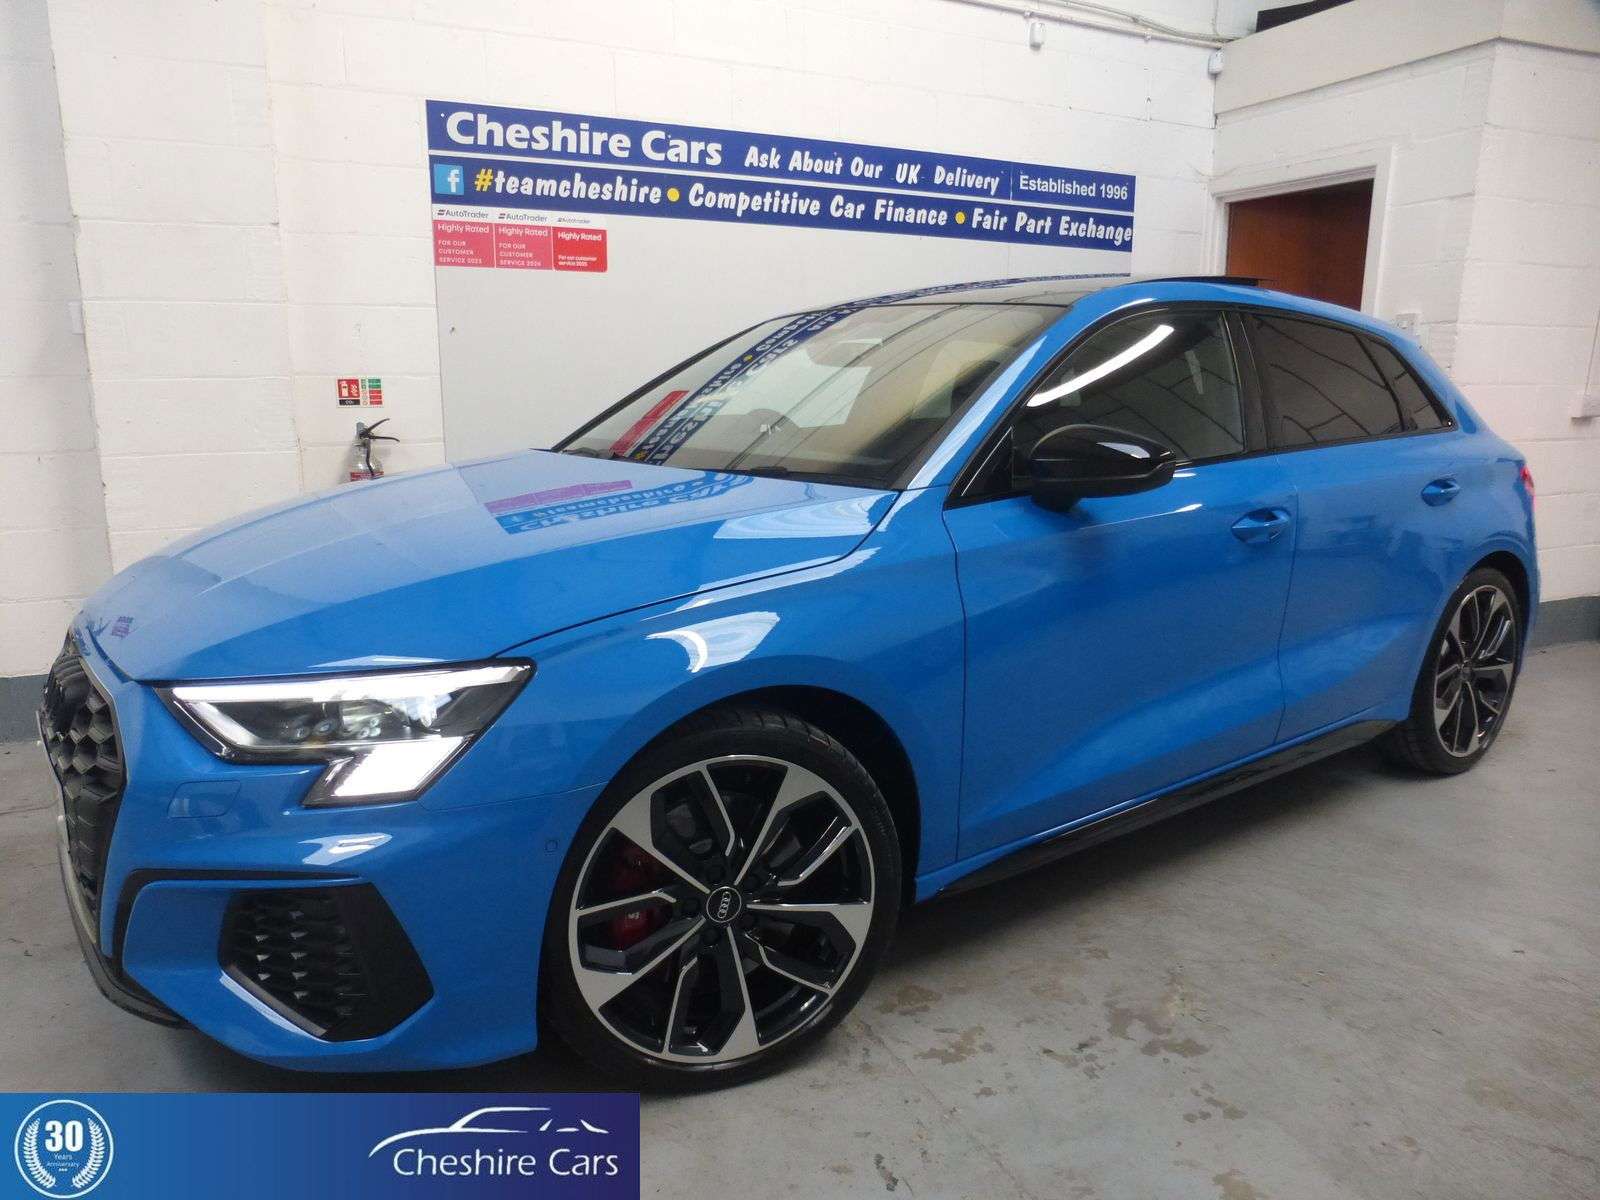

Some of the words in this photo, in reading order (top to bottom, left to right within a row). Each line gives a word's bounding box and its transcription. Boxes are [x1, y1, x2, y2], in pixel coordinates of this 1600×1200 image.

[446, 111, 631, 158] Cheshire
[641, 130, 722, 166] Cars
[744, 145, 784, 171] Ask
[788, 150, 843, 175] About
[850, 156, 883, 179] Our
[895, 163, 922, 184] UK
[934, 165, 1000, 196] Delivery
[1019, 174, 1096, 198] Established
[1100, 184, 1128, 200] 1996
[474, 167, 662, 205] #teamcheshire
[688, 182, 820, 218] Competitive
[830, 195, 865, 220] Car
[874, 198, 948, 227] Finance
[972, 207, 1008, 231] Fair
[1014, 211, 1052, 236] Part
[1059, 215, 1133, 247] Exchange
[446, 209, 489, 219] AutoTrader
[506, 213, 548, 222] AutoTrader
[437, 223, 464, 233] Highly
[465, 225, 490, 234] Rated
[498, 226, 524, 236] Highly
[524, 228, 549, 238] Rated
[557, 231, 580, 241] Highly
[580, 232, 602, 241] Rated
